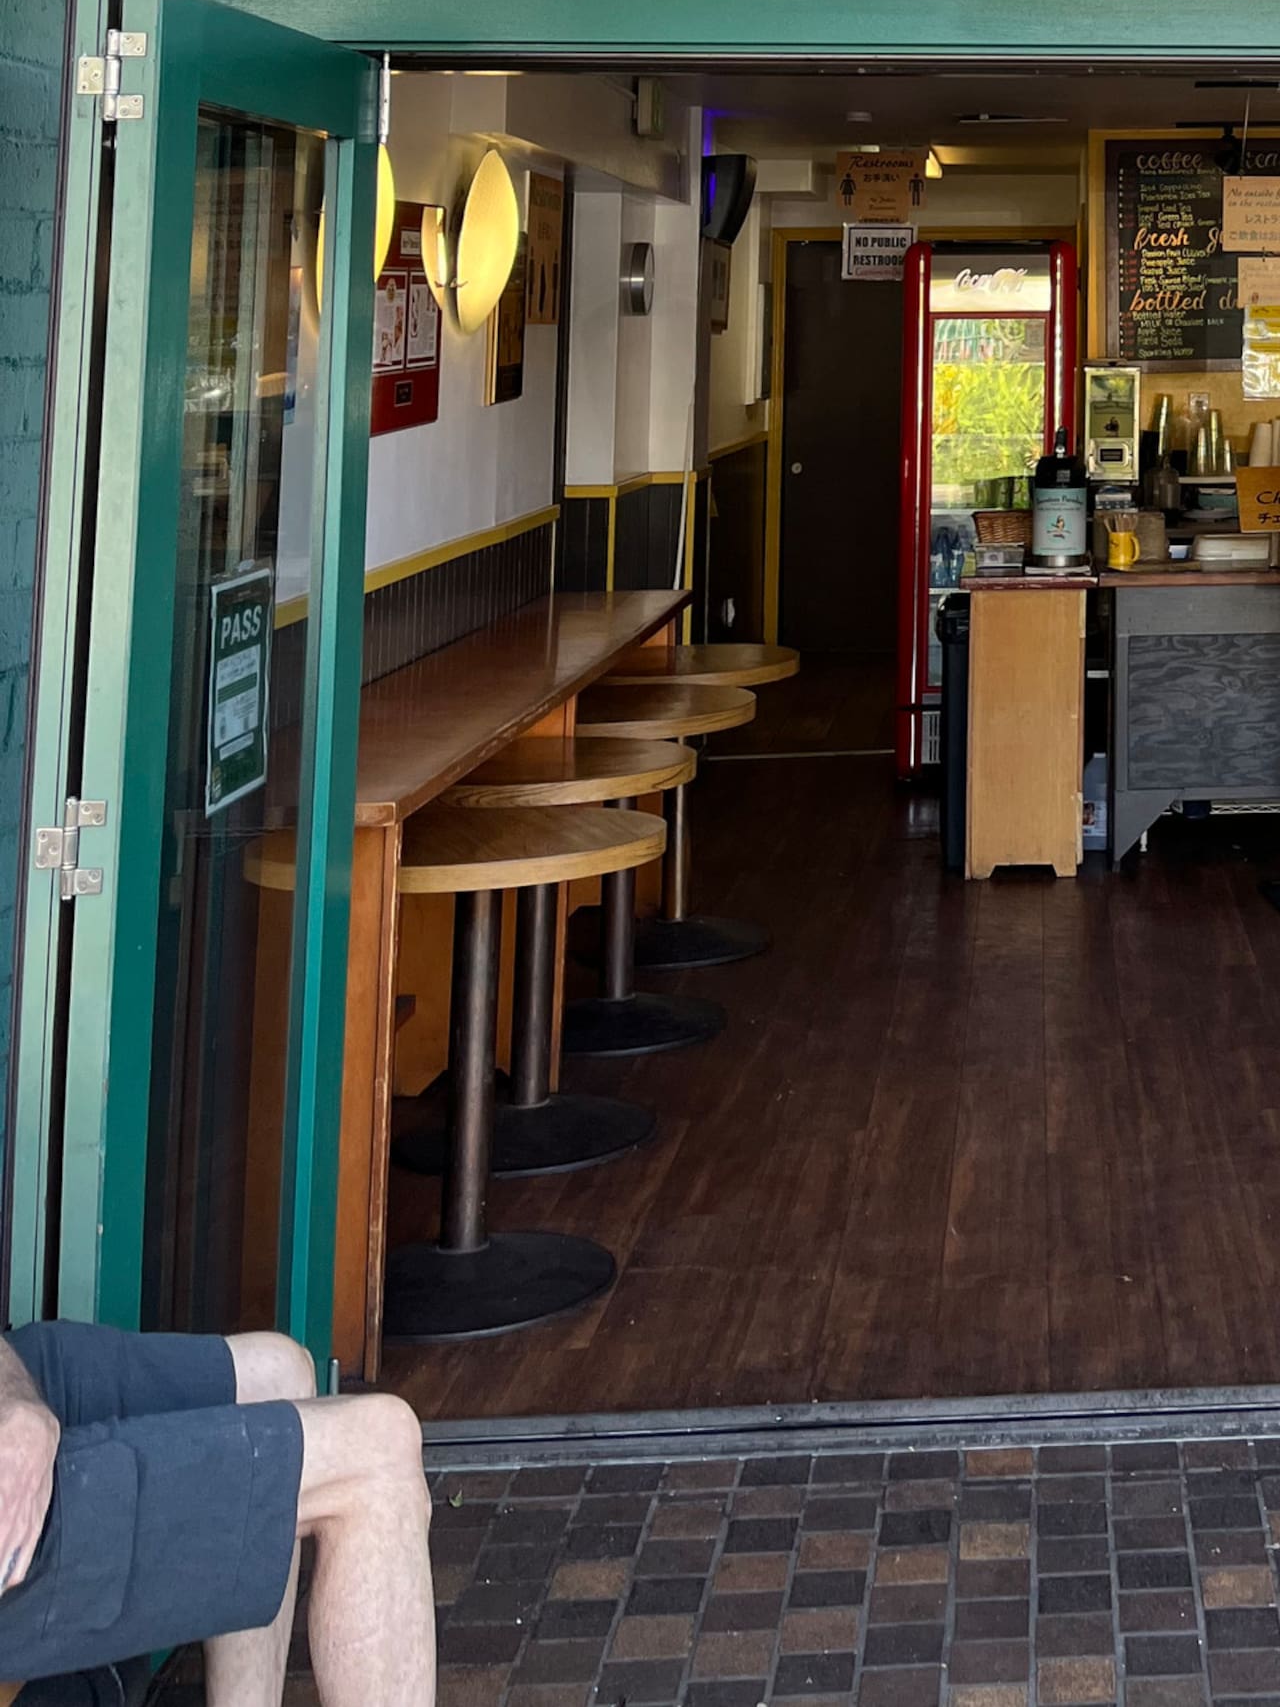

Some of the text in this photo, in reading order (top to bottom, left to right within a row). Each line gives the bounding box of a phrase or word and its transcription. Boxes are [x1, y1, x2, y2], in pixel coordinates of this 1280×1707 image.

[848, 155, 914, 170] Restrooms
[1136, 152, 1202, 169] coffee
[855, 237, 906, 248] NO PUBLIC
[1134, 226, 1190, 250] fresh
[1130, 289, 1206, 311] bottled
[219, 604, 262, 649] PASS
